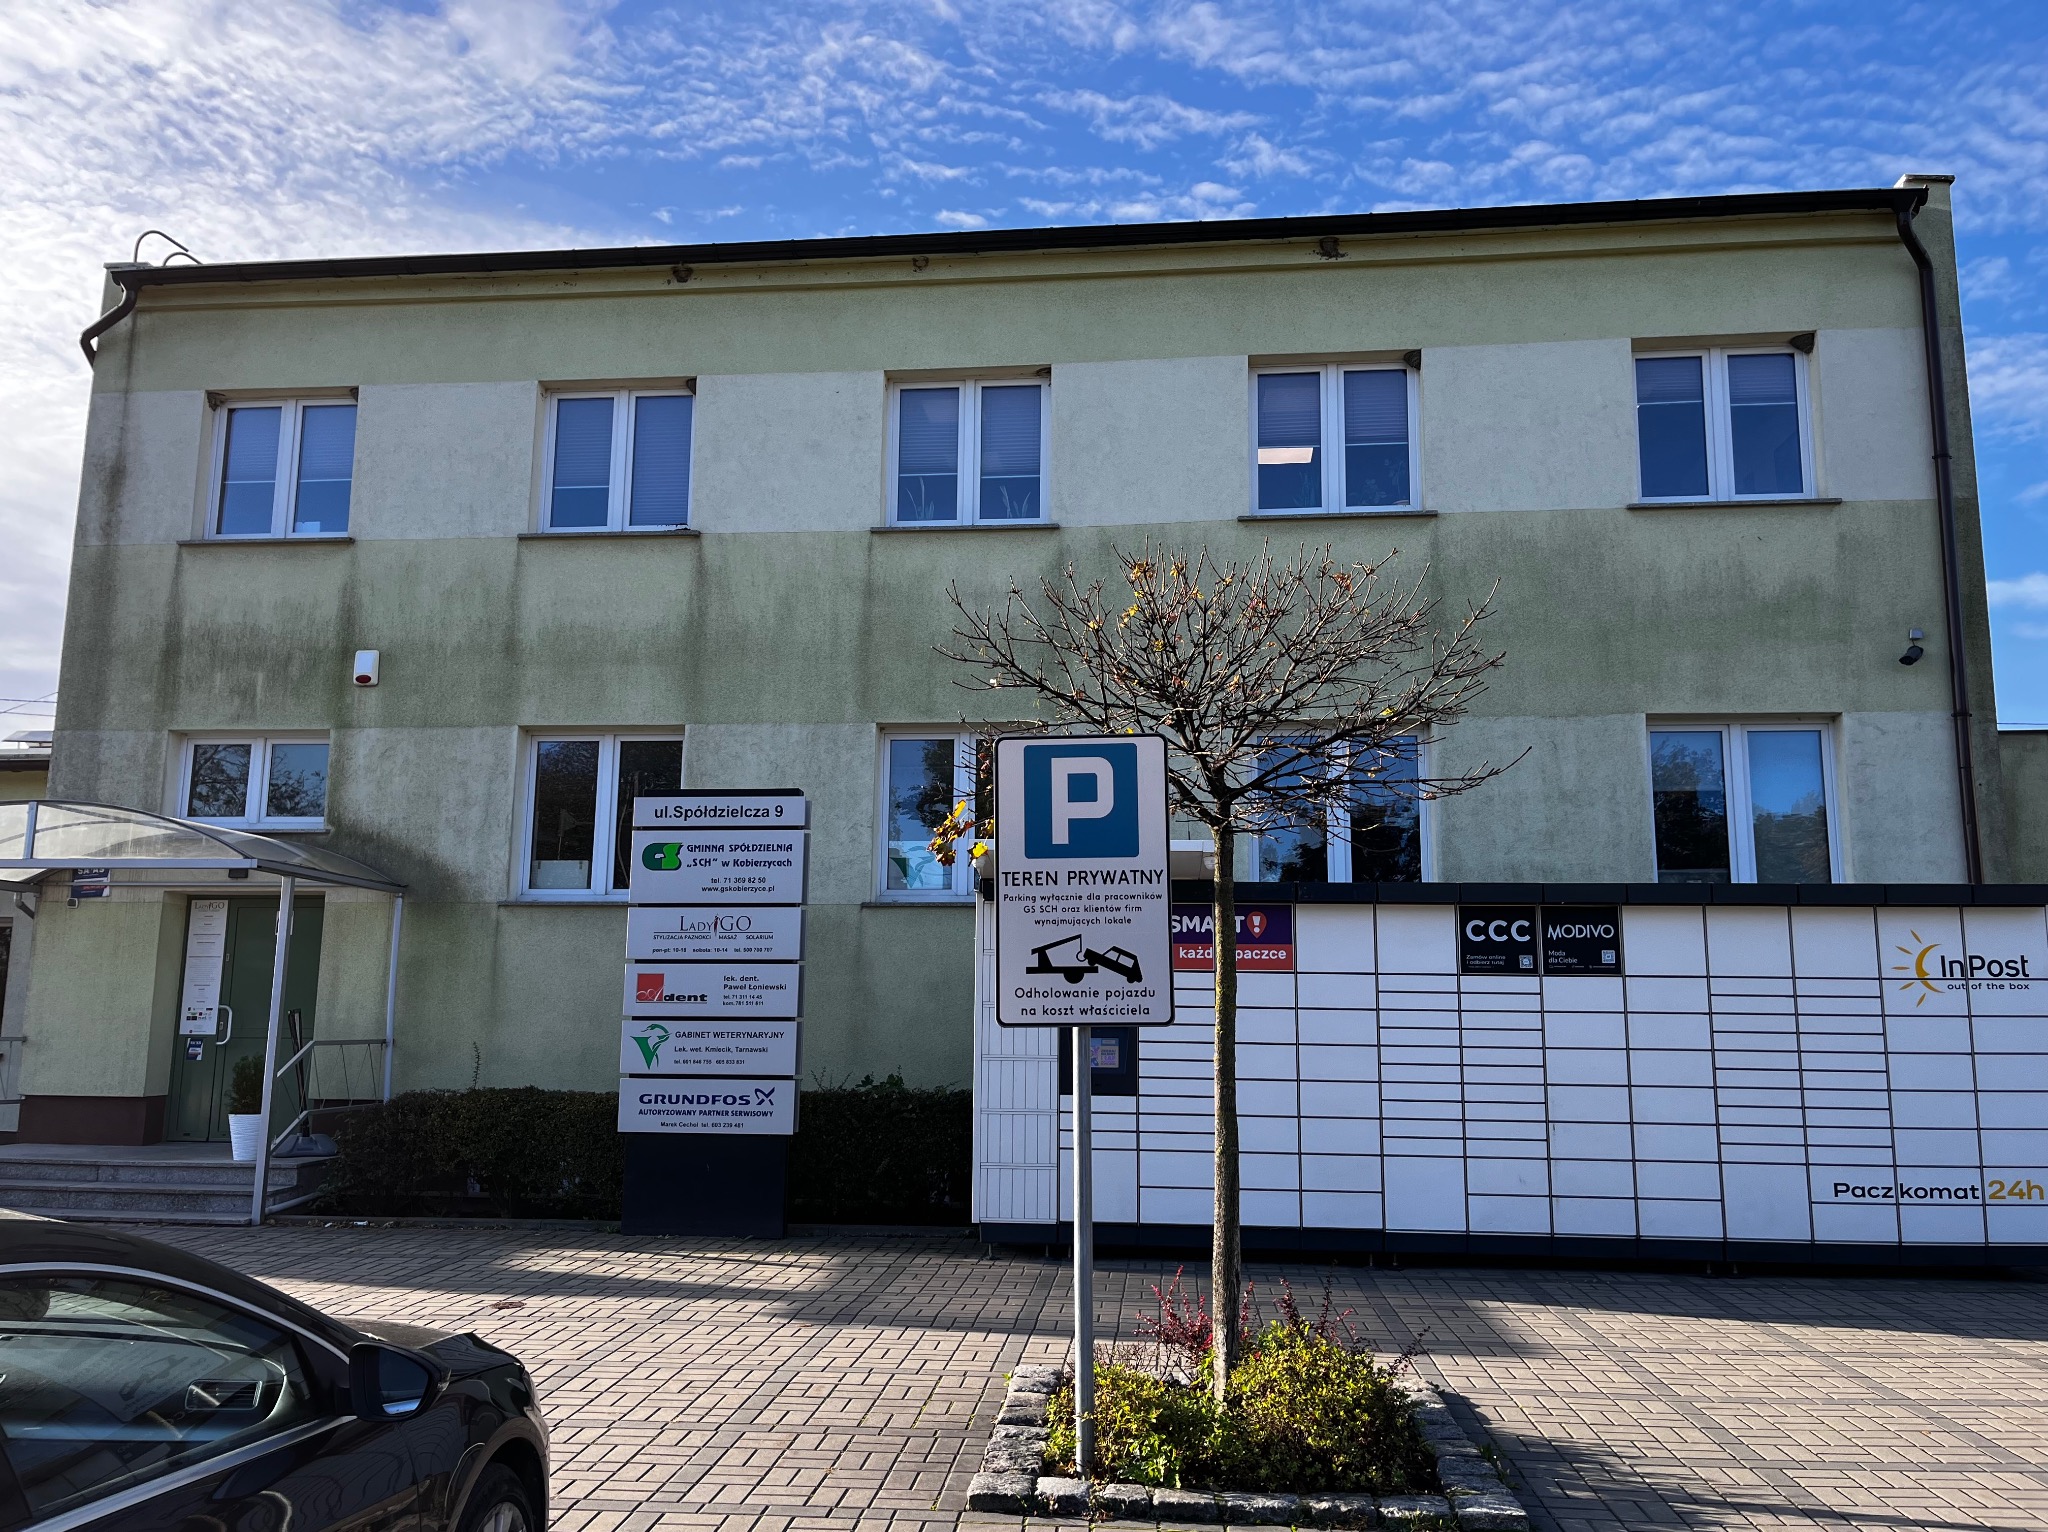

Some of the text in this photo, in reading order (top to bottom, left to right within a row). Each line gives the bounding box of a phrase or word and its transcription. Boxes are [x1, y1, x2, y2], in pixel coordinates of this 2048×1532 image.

[1051, 756, 1114, 844] P
[654, 804, 784, 821] ul.Spółdzielcza 9
[686, 843, 793, 852] GMINNA SPÓŁDZIELNIA
[733, 858, 793, 868] Kobierzycach
[758, 876, 766, 884] 50
[1002, 869, 1164, 886] TEREN PRYWATNY
[1004, 892, 1163, 903] Parking wyłącznie dla pracowników
[1039, 905, 1058, 913] SCH
[1084, 904, 1121, 912] klientów
[1124, 904, 1142, 912] firm
[1034, 916, 1132, 926] wynajmujących lokale
[1466, 920, 1531, 942] CCC
[1548, 924, 1614, 940] MODIVO
[1236, 949, 1287, 961] paczce
[1940, 955, 2030, 977] InPost
[1014, 987, 1156, 1001] Odholowanie pojazdu
[1021, 1004, 1150, 1016] na koszt właściciela
[675, 1031, 784, 1039] GABINET WETERYNARYJNY
[638, 1094, 751, 1106] GRUNDFOS
[1833, 1179, 2044, 1200] Paczkomat 24h
